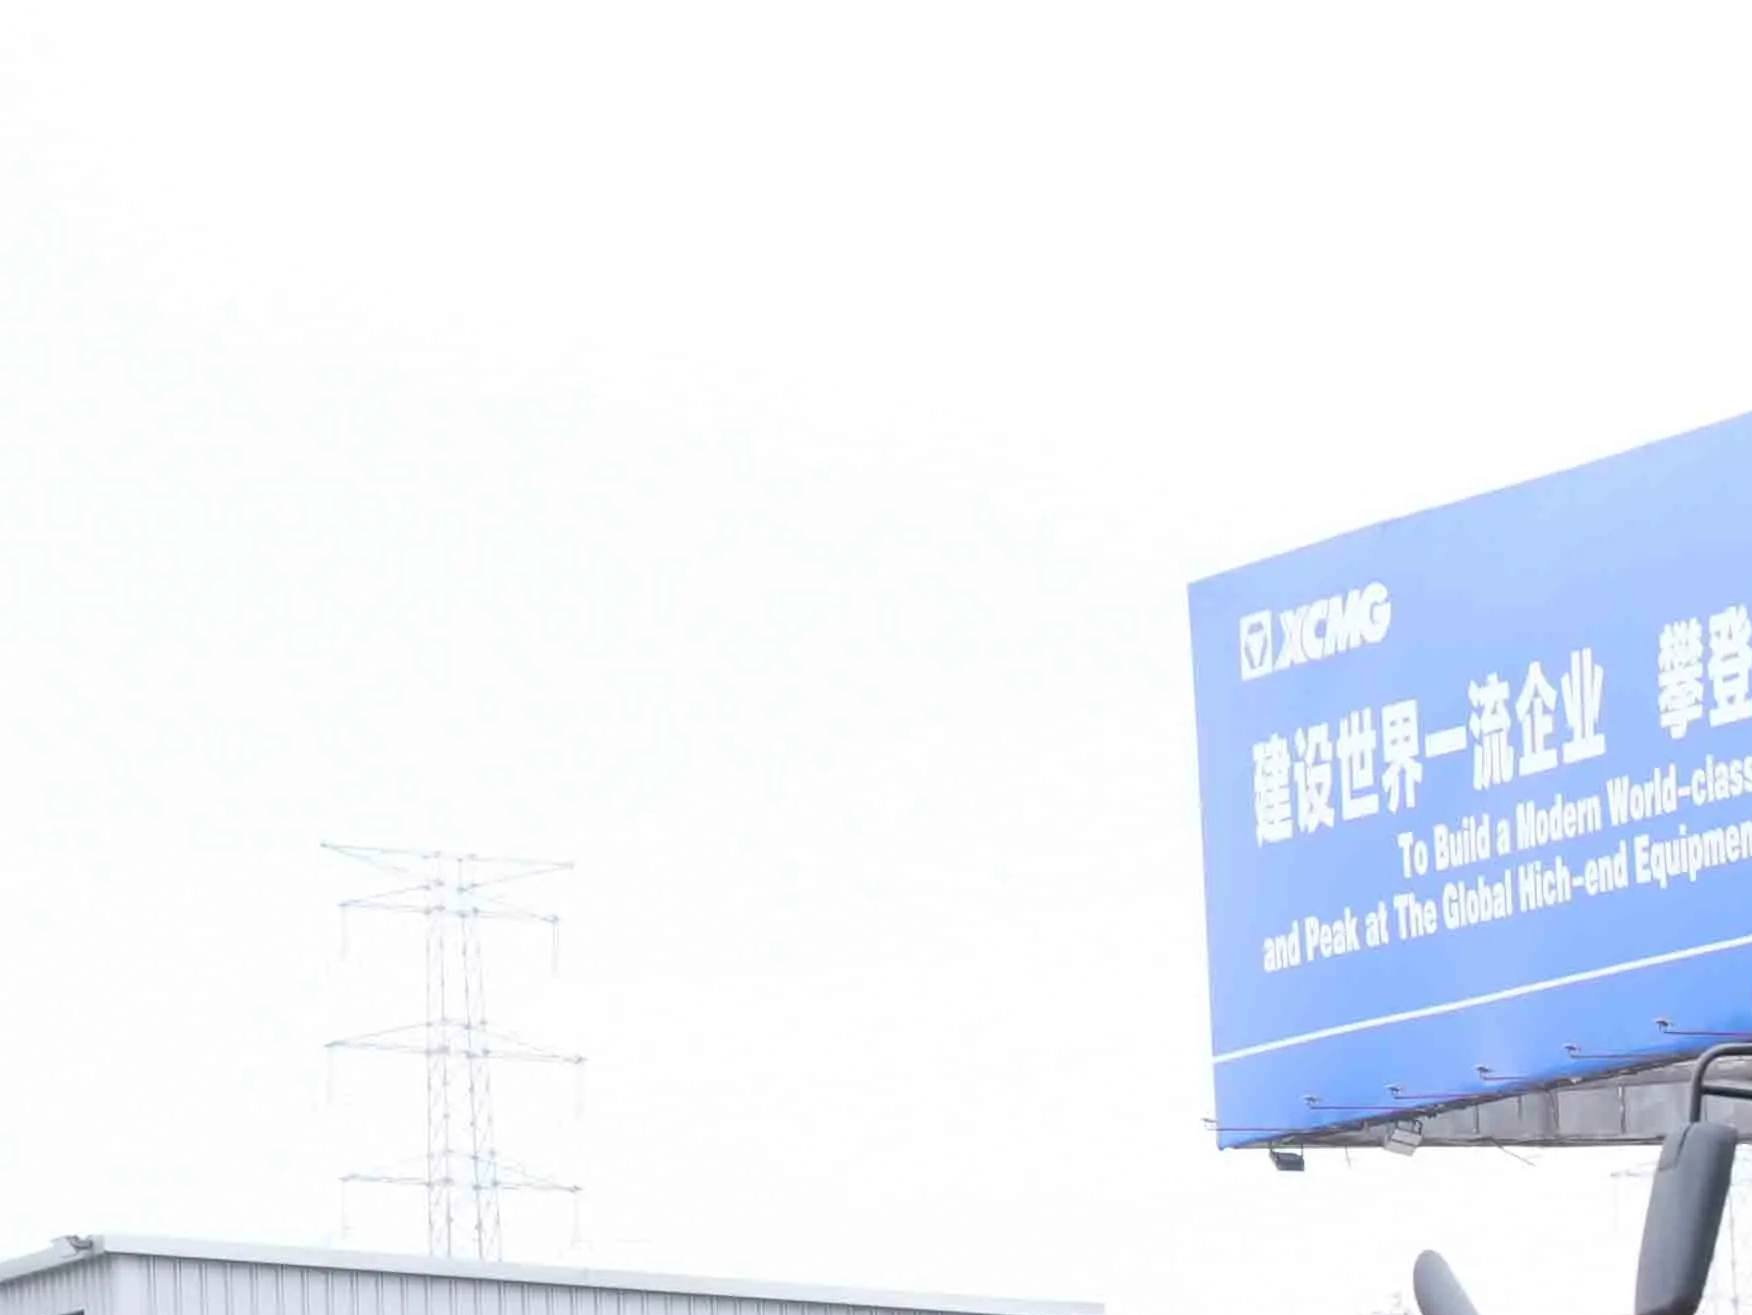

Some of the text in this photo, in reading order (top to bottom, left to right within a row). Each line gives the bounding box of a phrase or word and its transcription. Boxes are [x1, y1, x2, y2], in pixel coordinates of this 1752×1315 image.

[1273, 581, 1392, 671] XCMG
[1253, 648, 1607, 848] 建设世界一流企业
[1397, 831, 1428, 879] To
[1433, 812, 1491, 871] Build
[1496, 817, 1511, 856] a
[1516, 793, 1602, 850] Modern
[1262, 919, 1301, 972] and
[1304, 906, 1361, 962] Peak
[1366, 901, 1389, 948] at
[1393, 892, 1438, 940] The
[1442, 868, 1513, 930] Global
